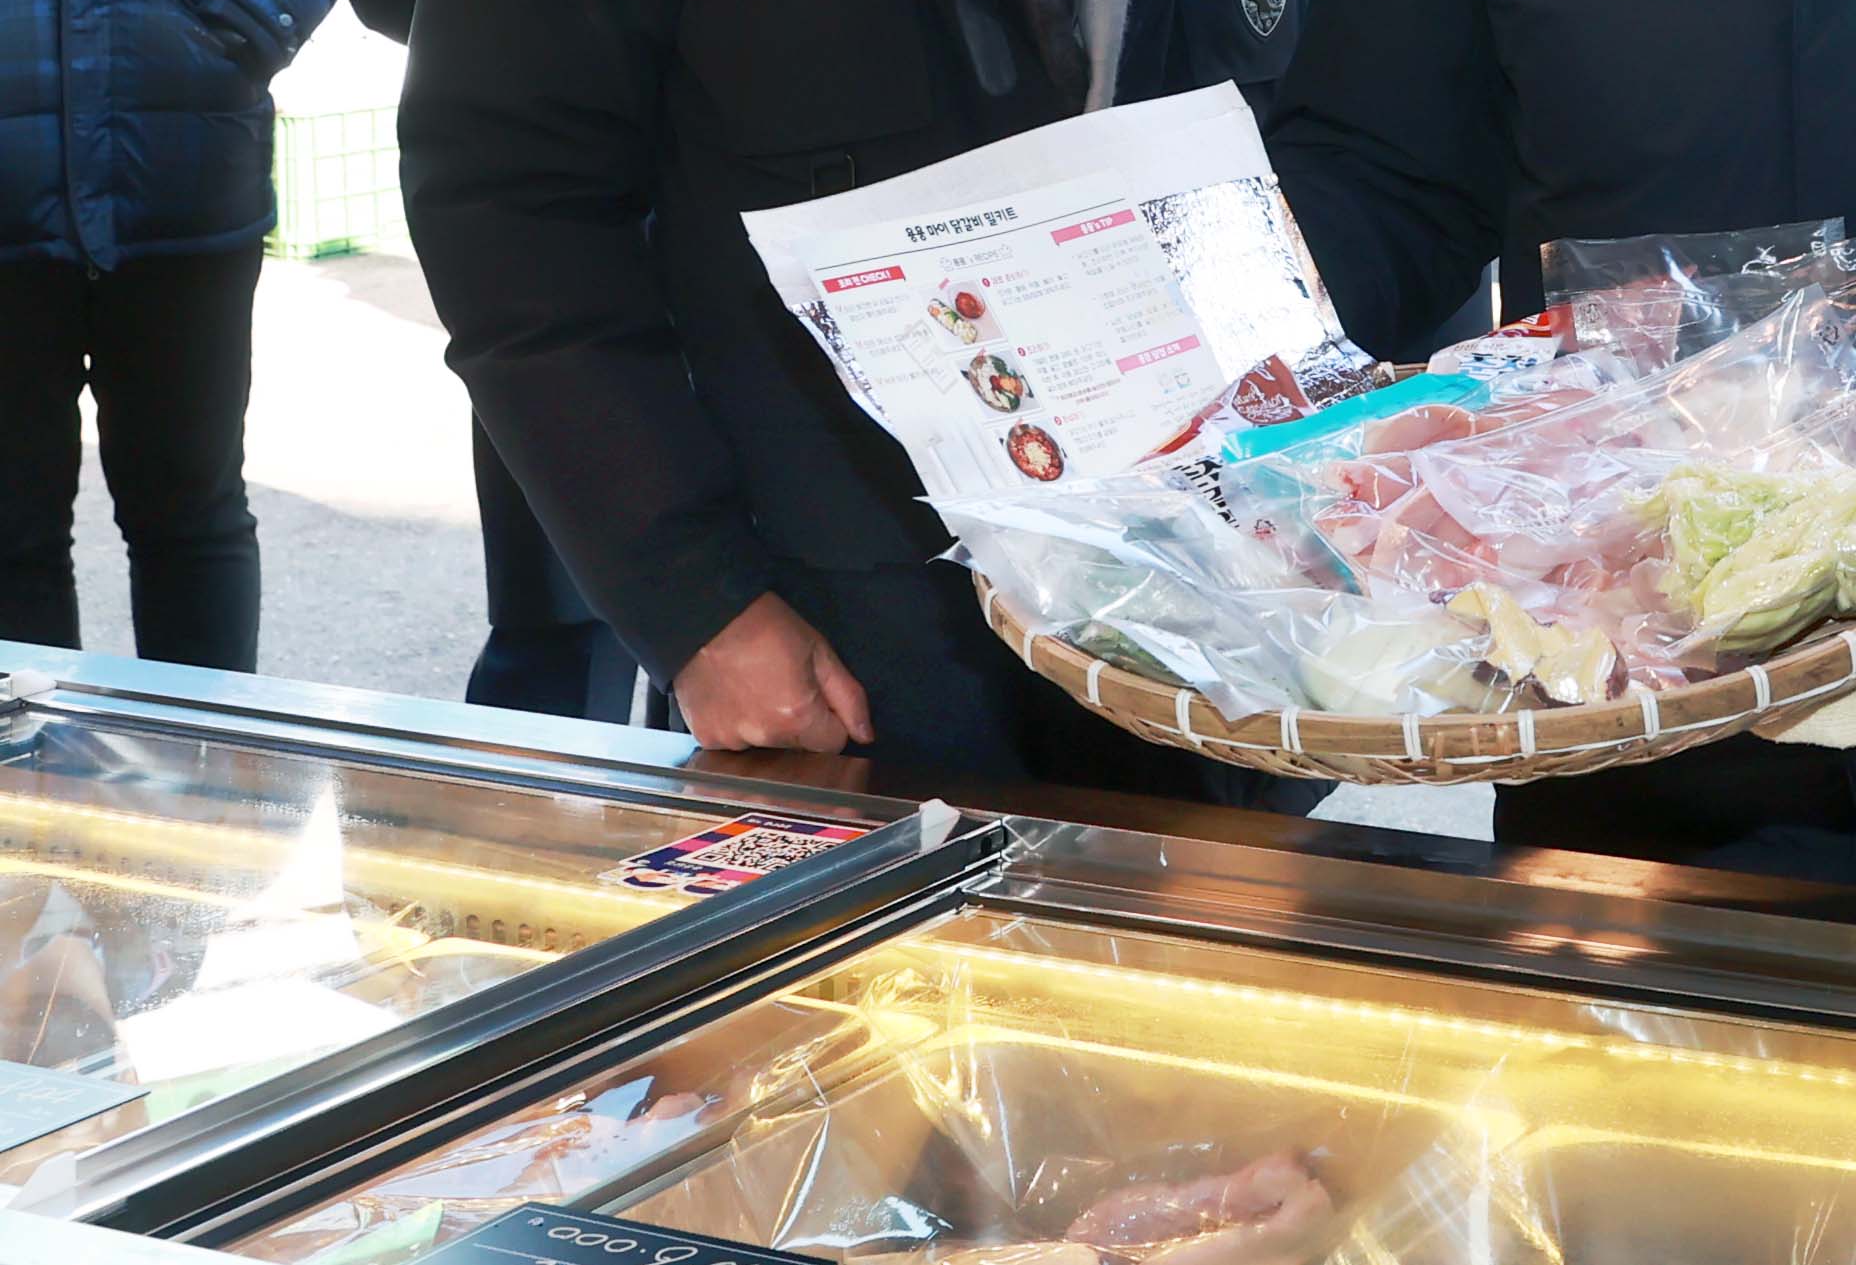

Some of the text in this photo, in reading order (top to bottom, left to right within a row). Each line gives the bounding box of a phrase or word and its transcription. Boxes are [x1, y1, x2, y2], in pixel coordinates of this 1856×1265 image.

[905, 206, 1019, 243] 용용 마이 닭갈비 밀키트
